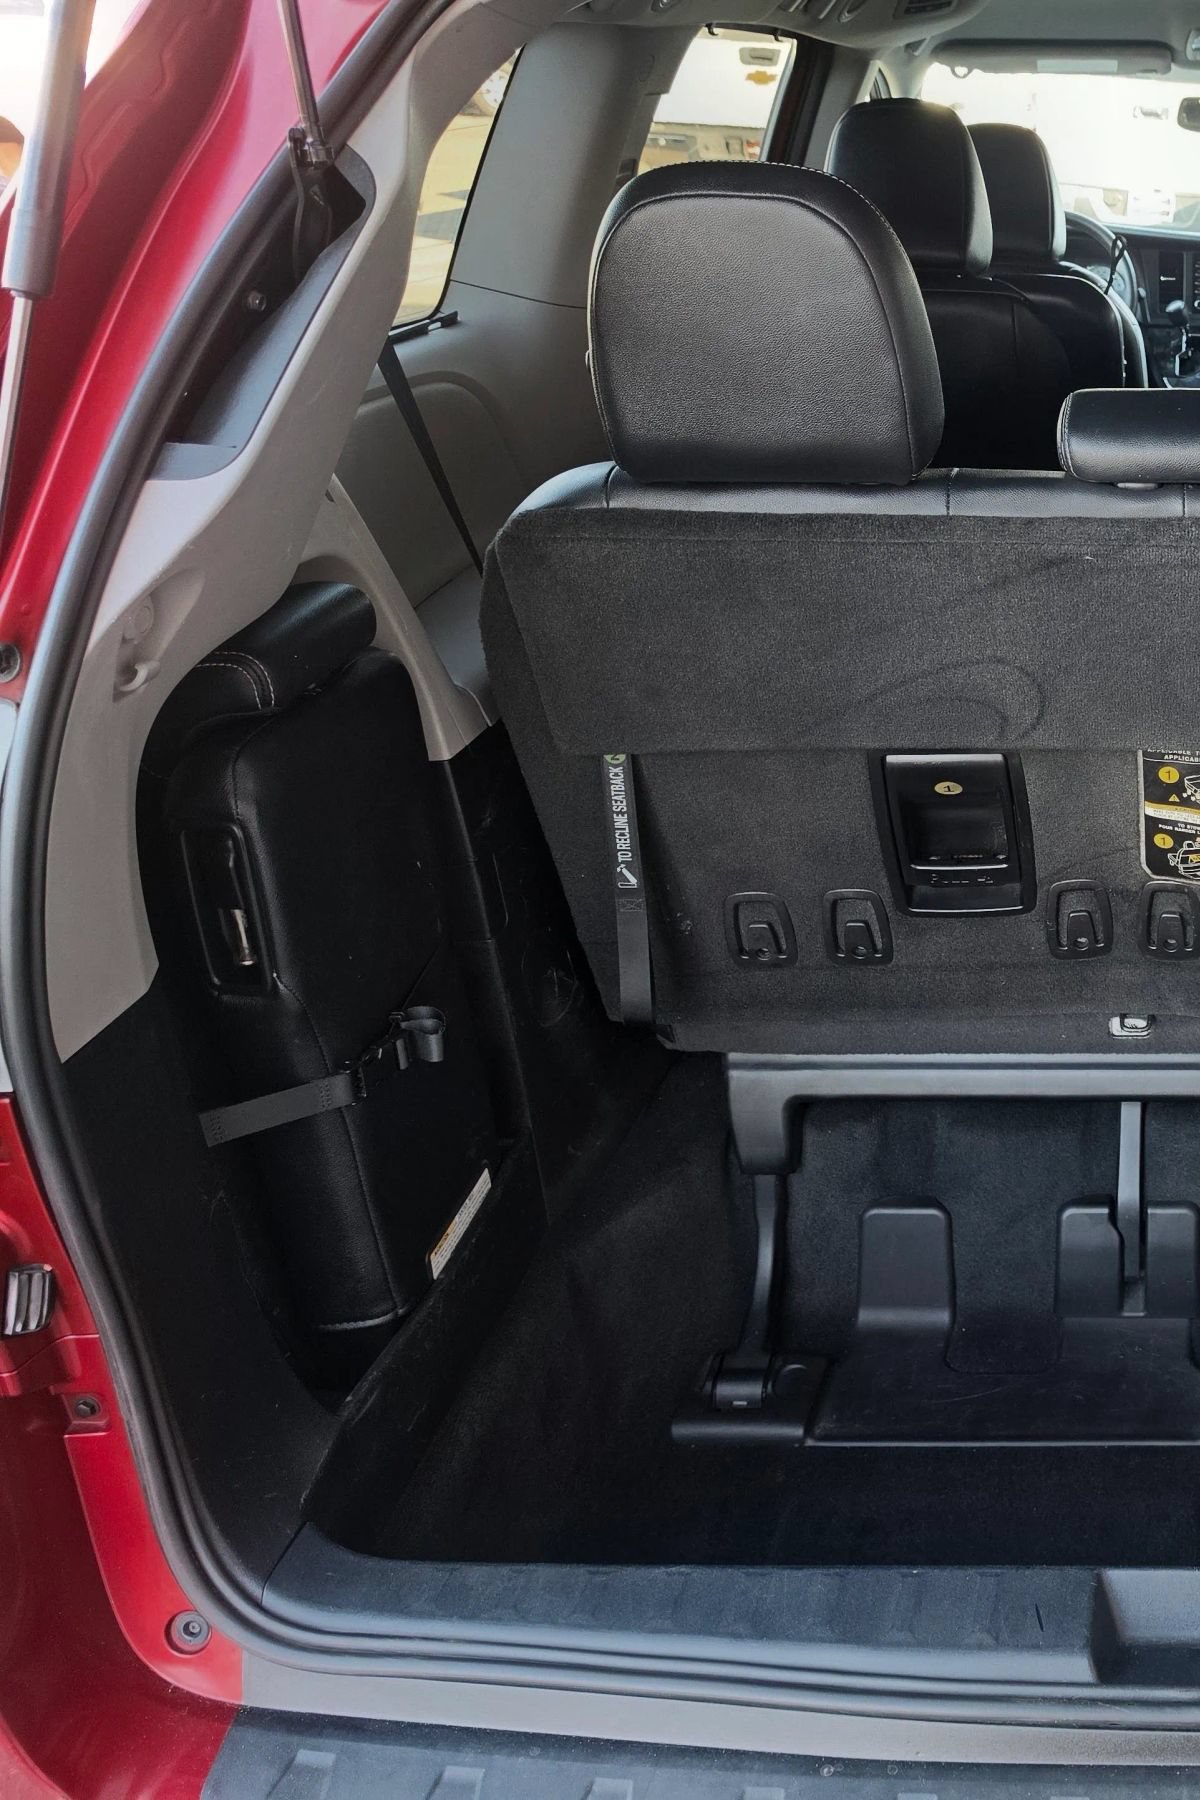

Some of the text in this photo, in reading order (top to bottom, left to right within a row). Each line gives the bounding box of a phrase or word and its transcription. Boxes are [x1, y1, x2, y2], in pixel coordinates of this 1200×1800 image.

[609, 766, 627, 812] SEATBACK
[943, 785, 954, 793] 1
[614, 814, 631, 850] RECLINE
[618, 851, 632, 862] TO
